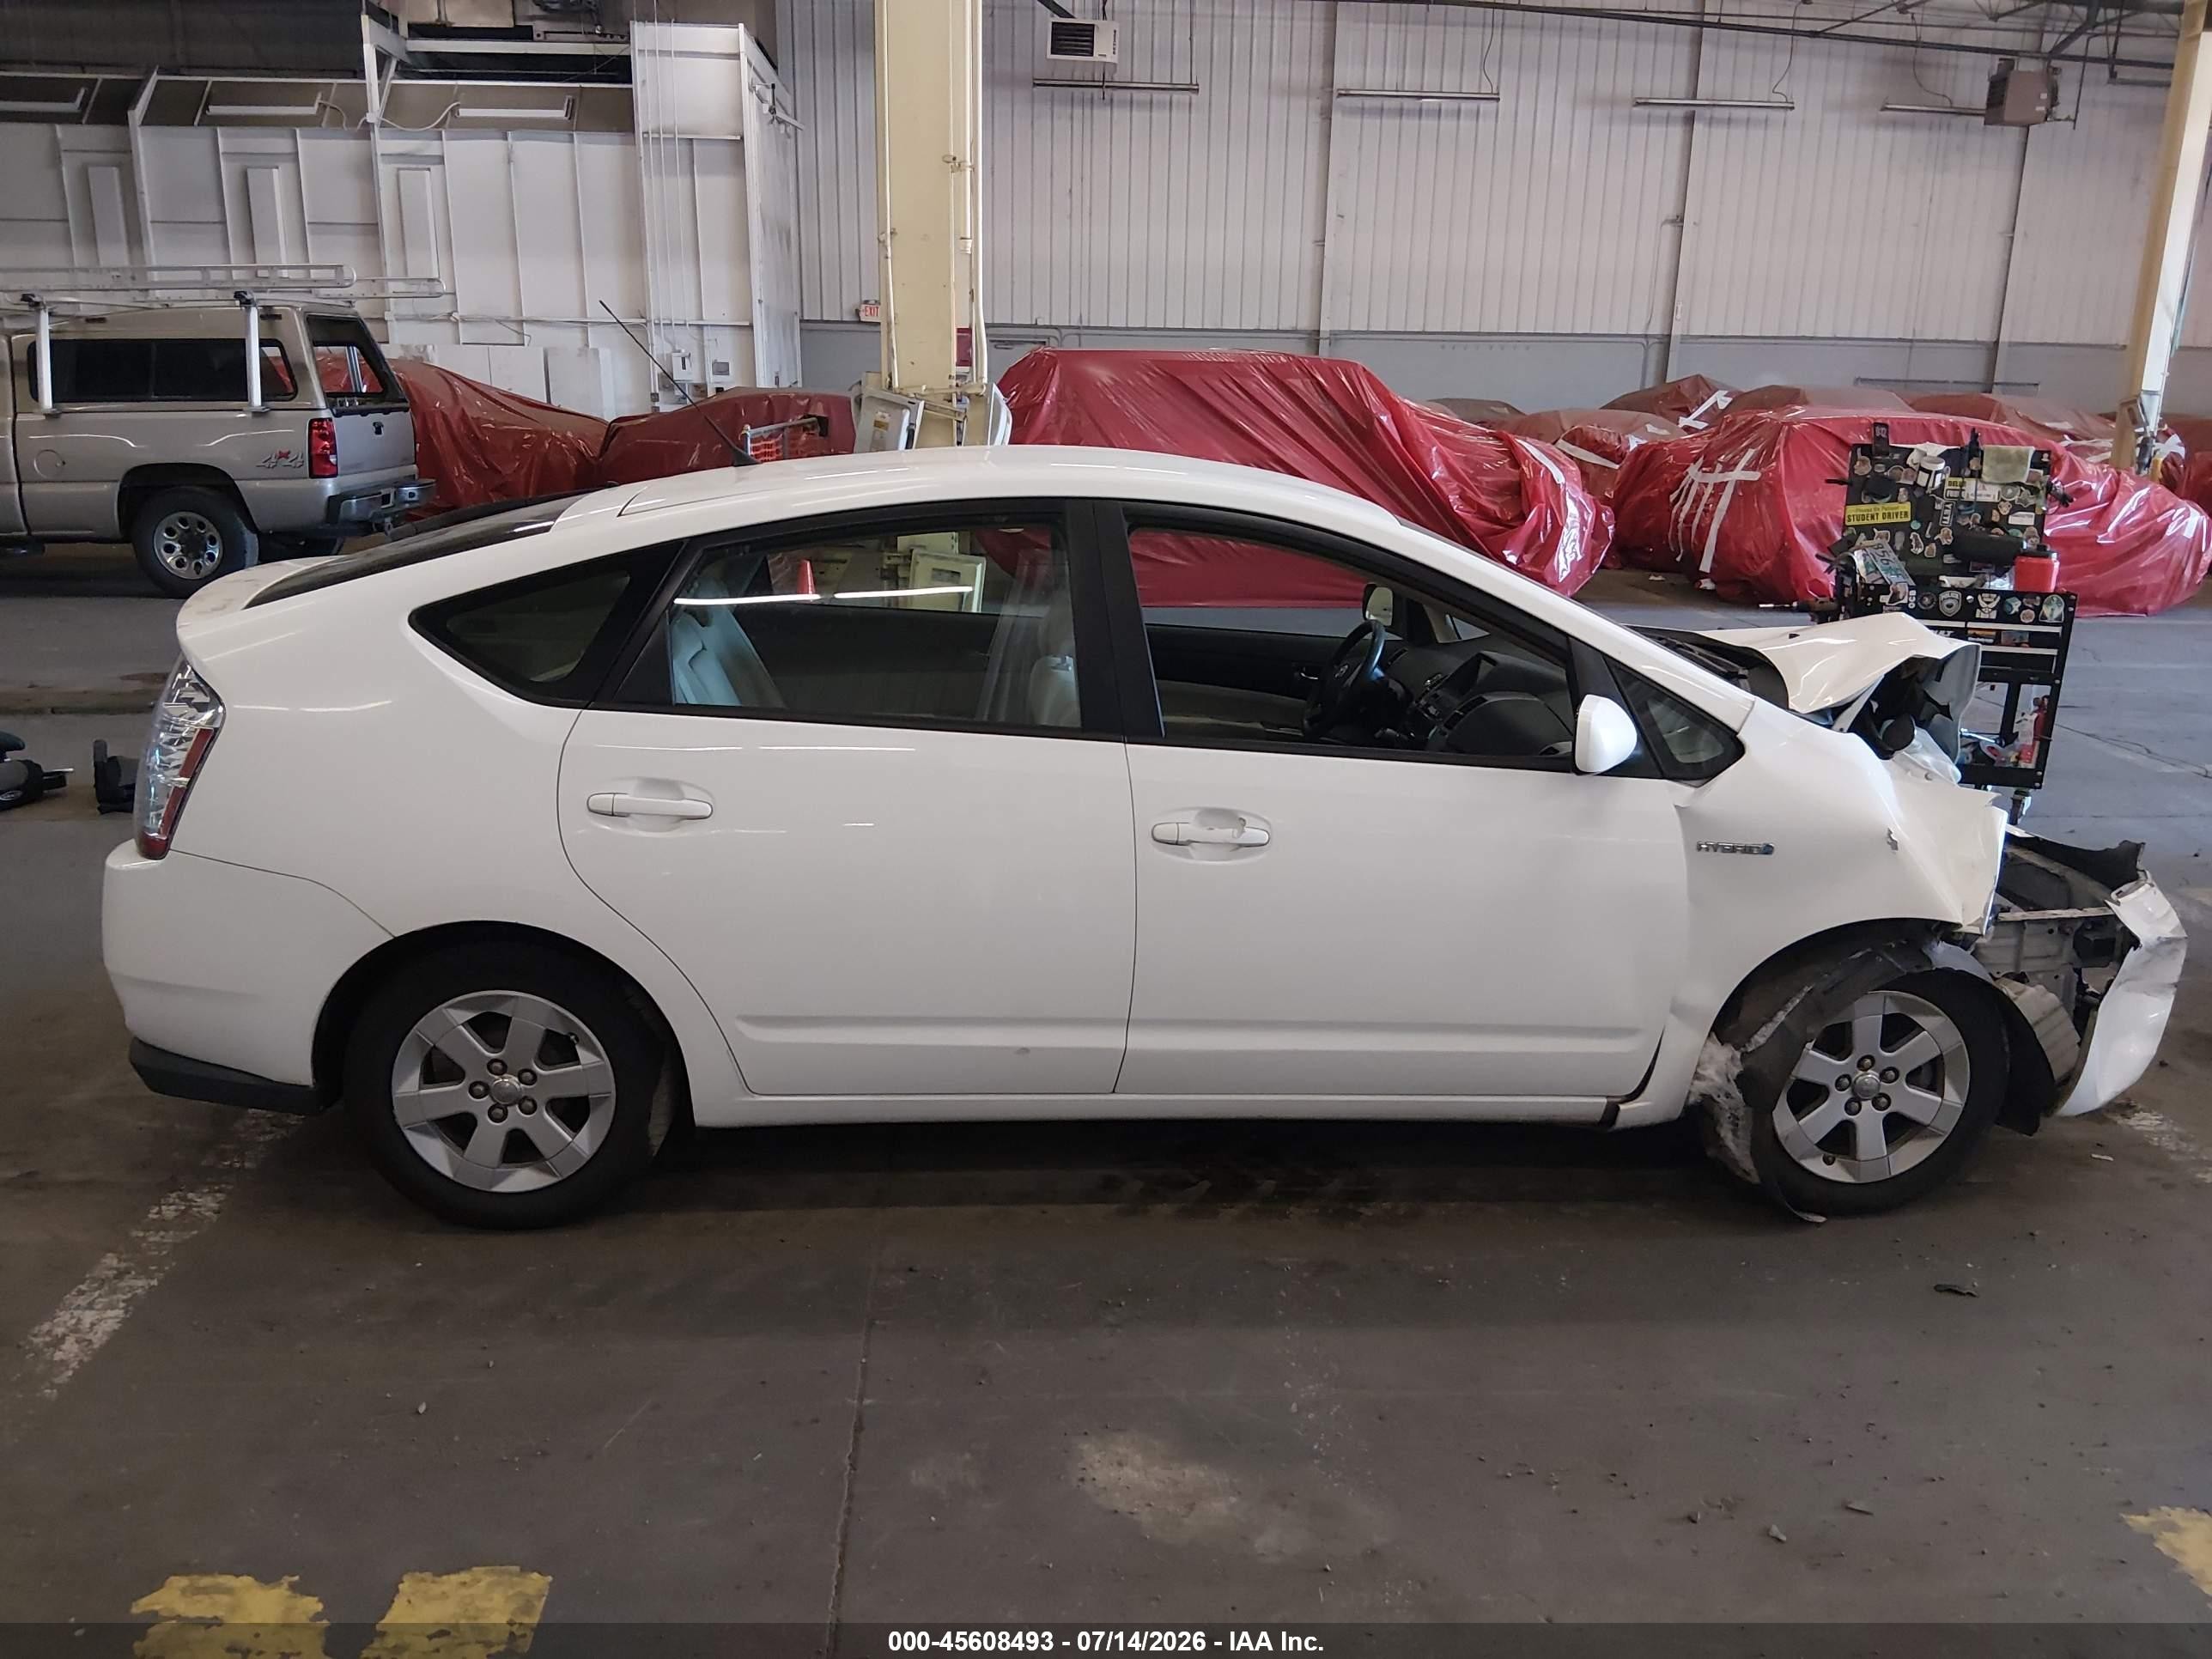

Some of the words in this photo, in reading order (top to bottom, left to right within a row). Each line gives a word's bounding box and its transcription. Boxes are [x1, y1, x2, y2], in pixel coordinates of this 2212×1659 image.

[865, 306, 879, 317] EXIT
[1847, 513, 1880, 523] STUDENT
[1881, 510, 1909, 520] DRIVER
[1942, 503, 1953, 525] YETI
[1697, 842, 1760, 855] HYBRID
